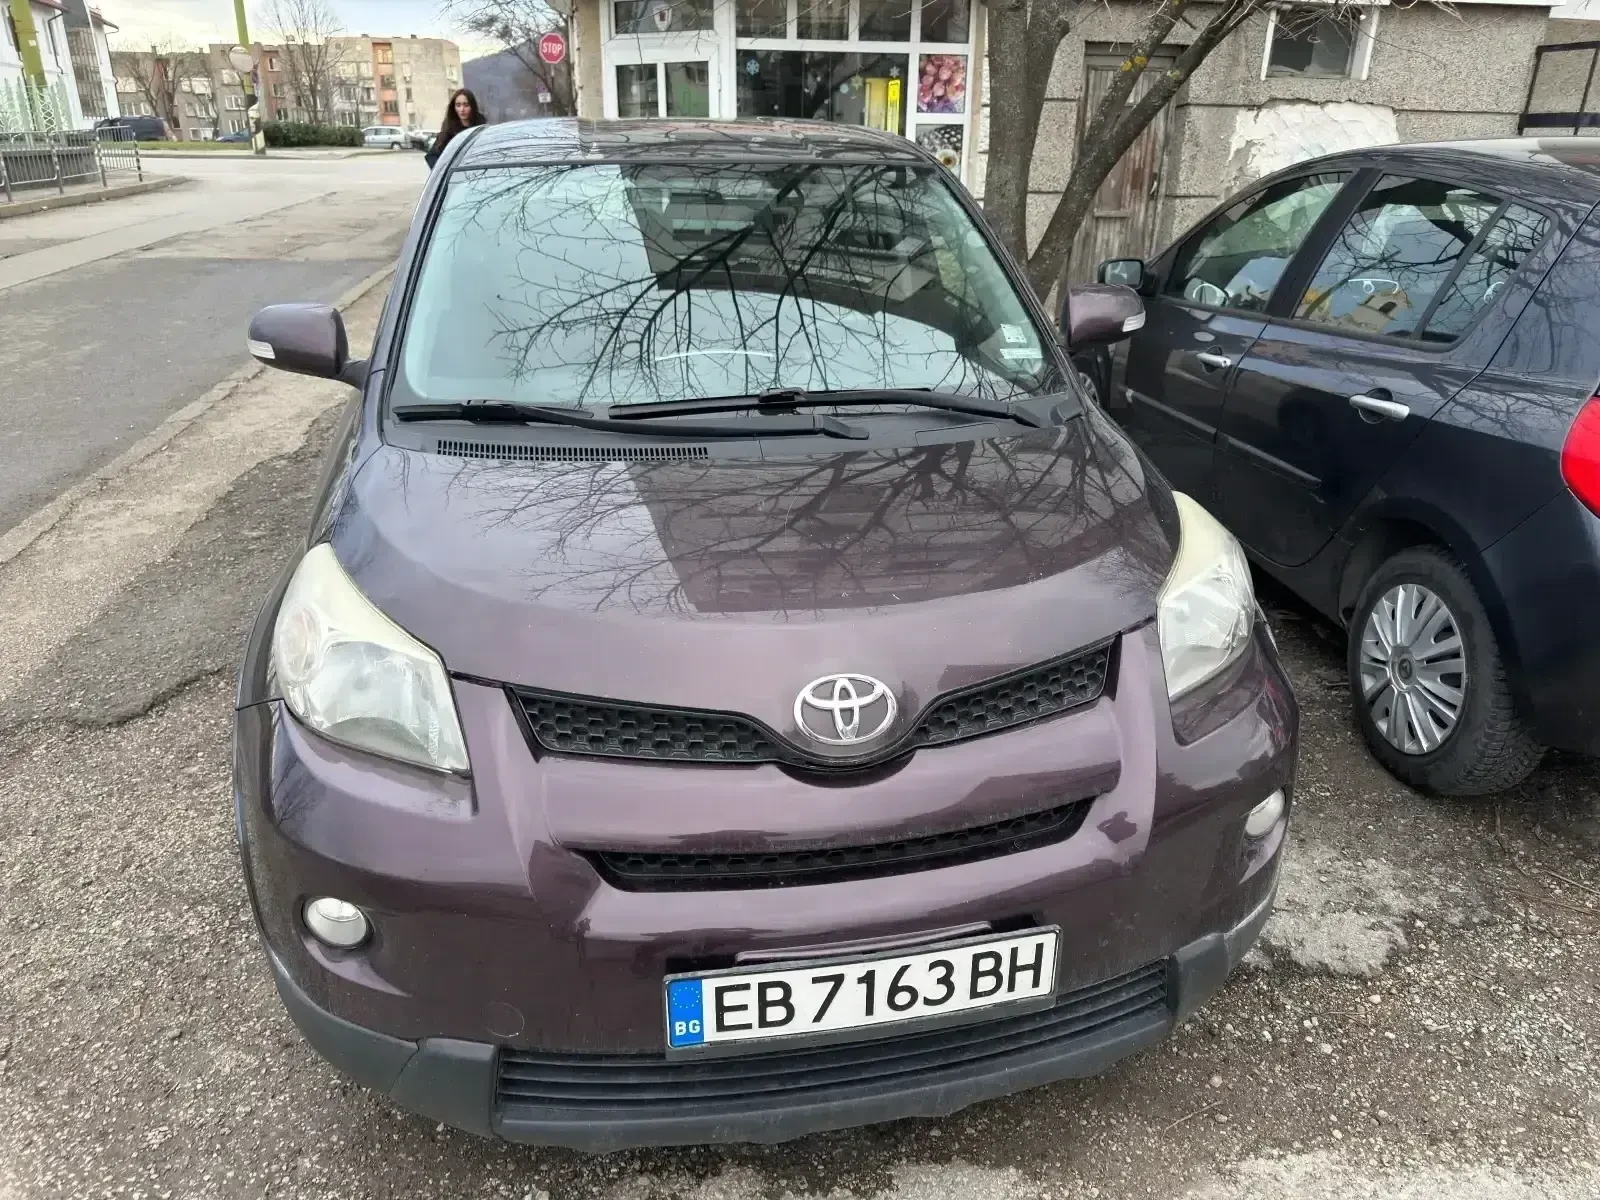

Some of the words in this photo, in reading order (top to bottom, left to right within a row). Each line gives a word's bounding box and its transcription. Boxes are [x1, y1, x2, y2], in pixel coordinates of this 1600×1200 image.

[542, 42, 562, 55] STOP
[715, 980, 796, 1033] EB
[811, 959, 956, 1024] 7163
[969, 942, 1045, 1000] BH
[675, 1019, 701, 1036] BG
